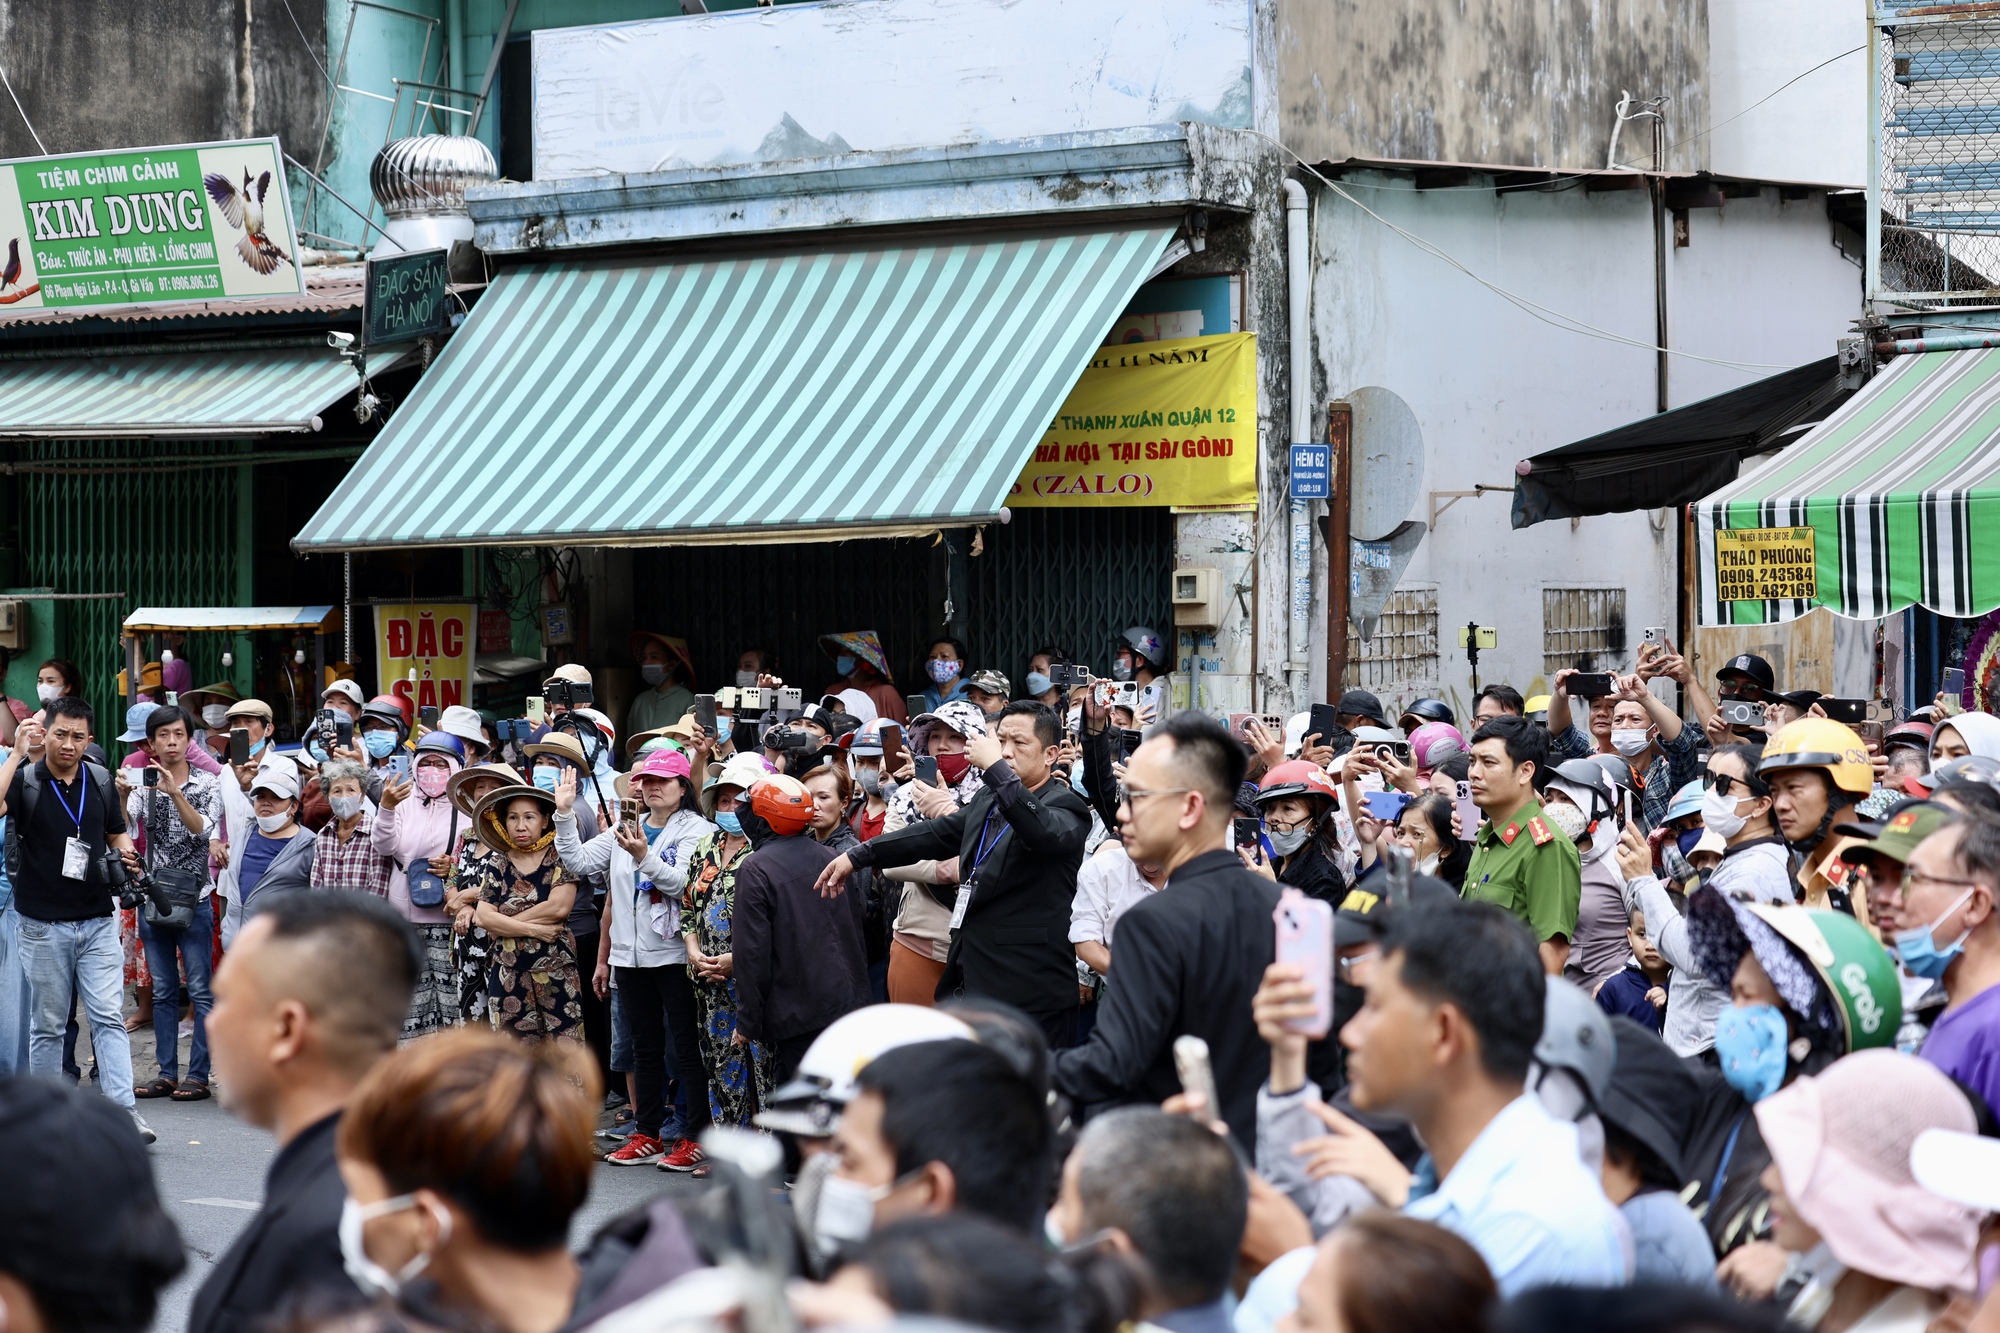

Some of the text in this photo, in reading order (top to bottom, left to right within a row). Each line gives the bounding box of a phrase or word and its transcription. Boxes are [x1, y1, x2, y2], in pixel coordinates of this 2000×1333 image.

[37, 157, 179, 190] TIỆM CHIM CẢNH
[27, 189, 204, 241] KIM DUNG
[37, 251, 66, 270] Bán:
[67, 246, 92, 267] THỨC
[93, 246, 107, 266] ĂN
[113, 247, 132, 267] PHỤ
[134, 241, 157, 266] KIỆN
[163, 237, 189, 262] LỒNG
[189, 242, 214, 260] CHIM
[45, 284, 54, 298] 66
[54, 284, 73, 300] Phạm
[73, 282, 87, 298] Ngũ
[87, 281, 101, 296] Lão
[130, 278, 140, 293] Gò
[140, 276, 154, 294] Vấp
[378, 260, 443, 301] ĐẶC SẢN
[384, 293, 434, 330] HÀ NỘI
[1149, 348, 1209, 365] NĂM
[1060, 415, 1117, 432] THẠNH
[1119, 410, 1163, 429] XUÂN
[1167, 406, 1212, 427] QUẬN
[1217, 408, 1236, 423] 12
[1064, 441, 1100, 465] NỘI
[1108, 441, 1141, 465] TẠI
[1145, 438, 1179, 460] SÀI
[1295, 449, 1325, 467] HẺM 62
[1032, 473, 1154, 498] (ZALO)
[1720, 544, 1812, 566] THẢO PHƯƠNG
[1720, 567, 1813, 584] 0909.243584
[1720, 582, 1815, 599] 0919.482169
[386, 610, 465, 666] ĐẶC
[1841, 961, 1885, 1035] Grab
